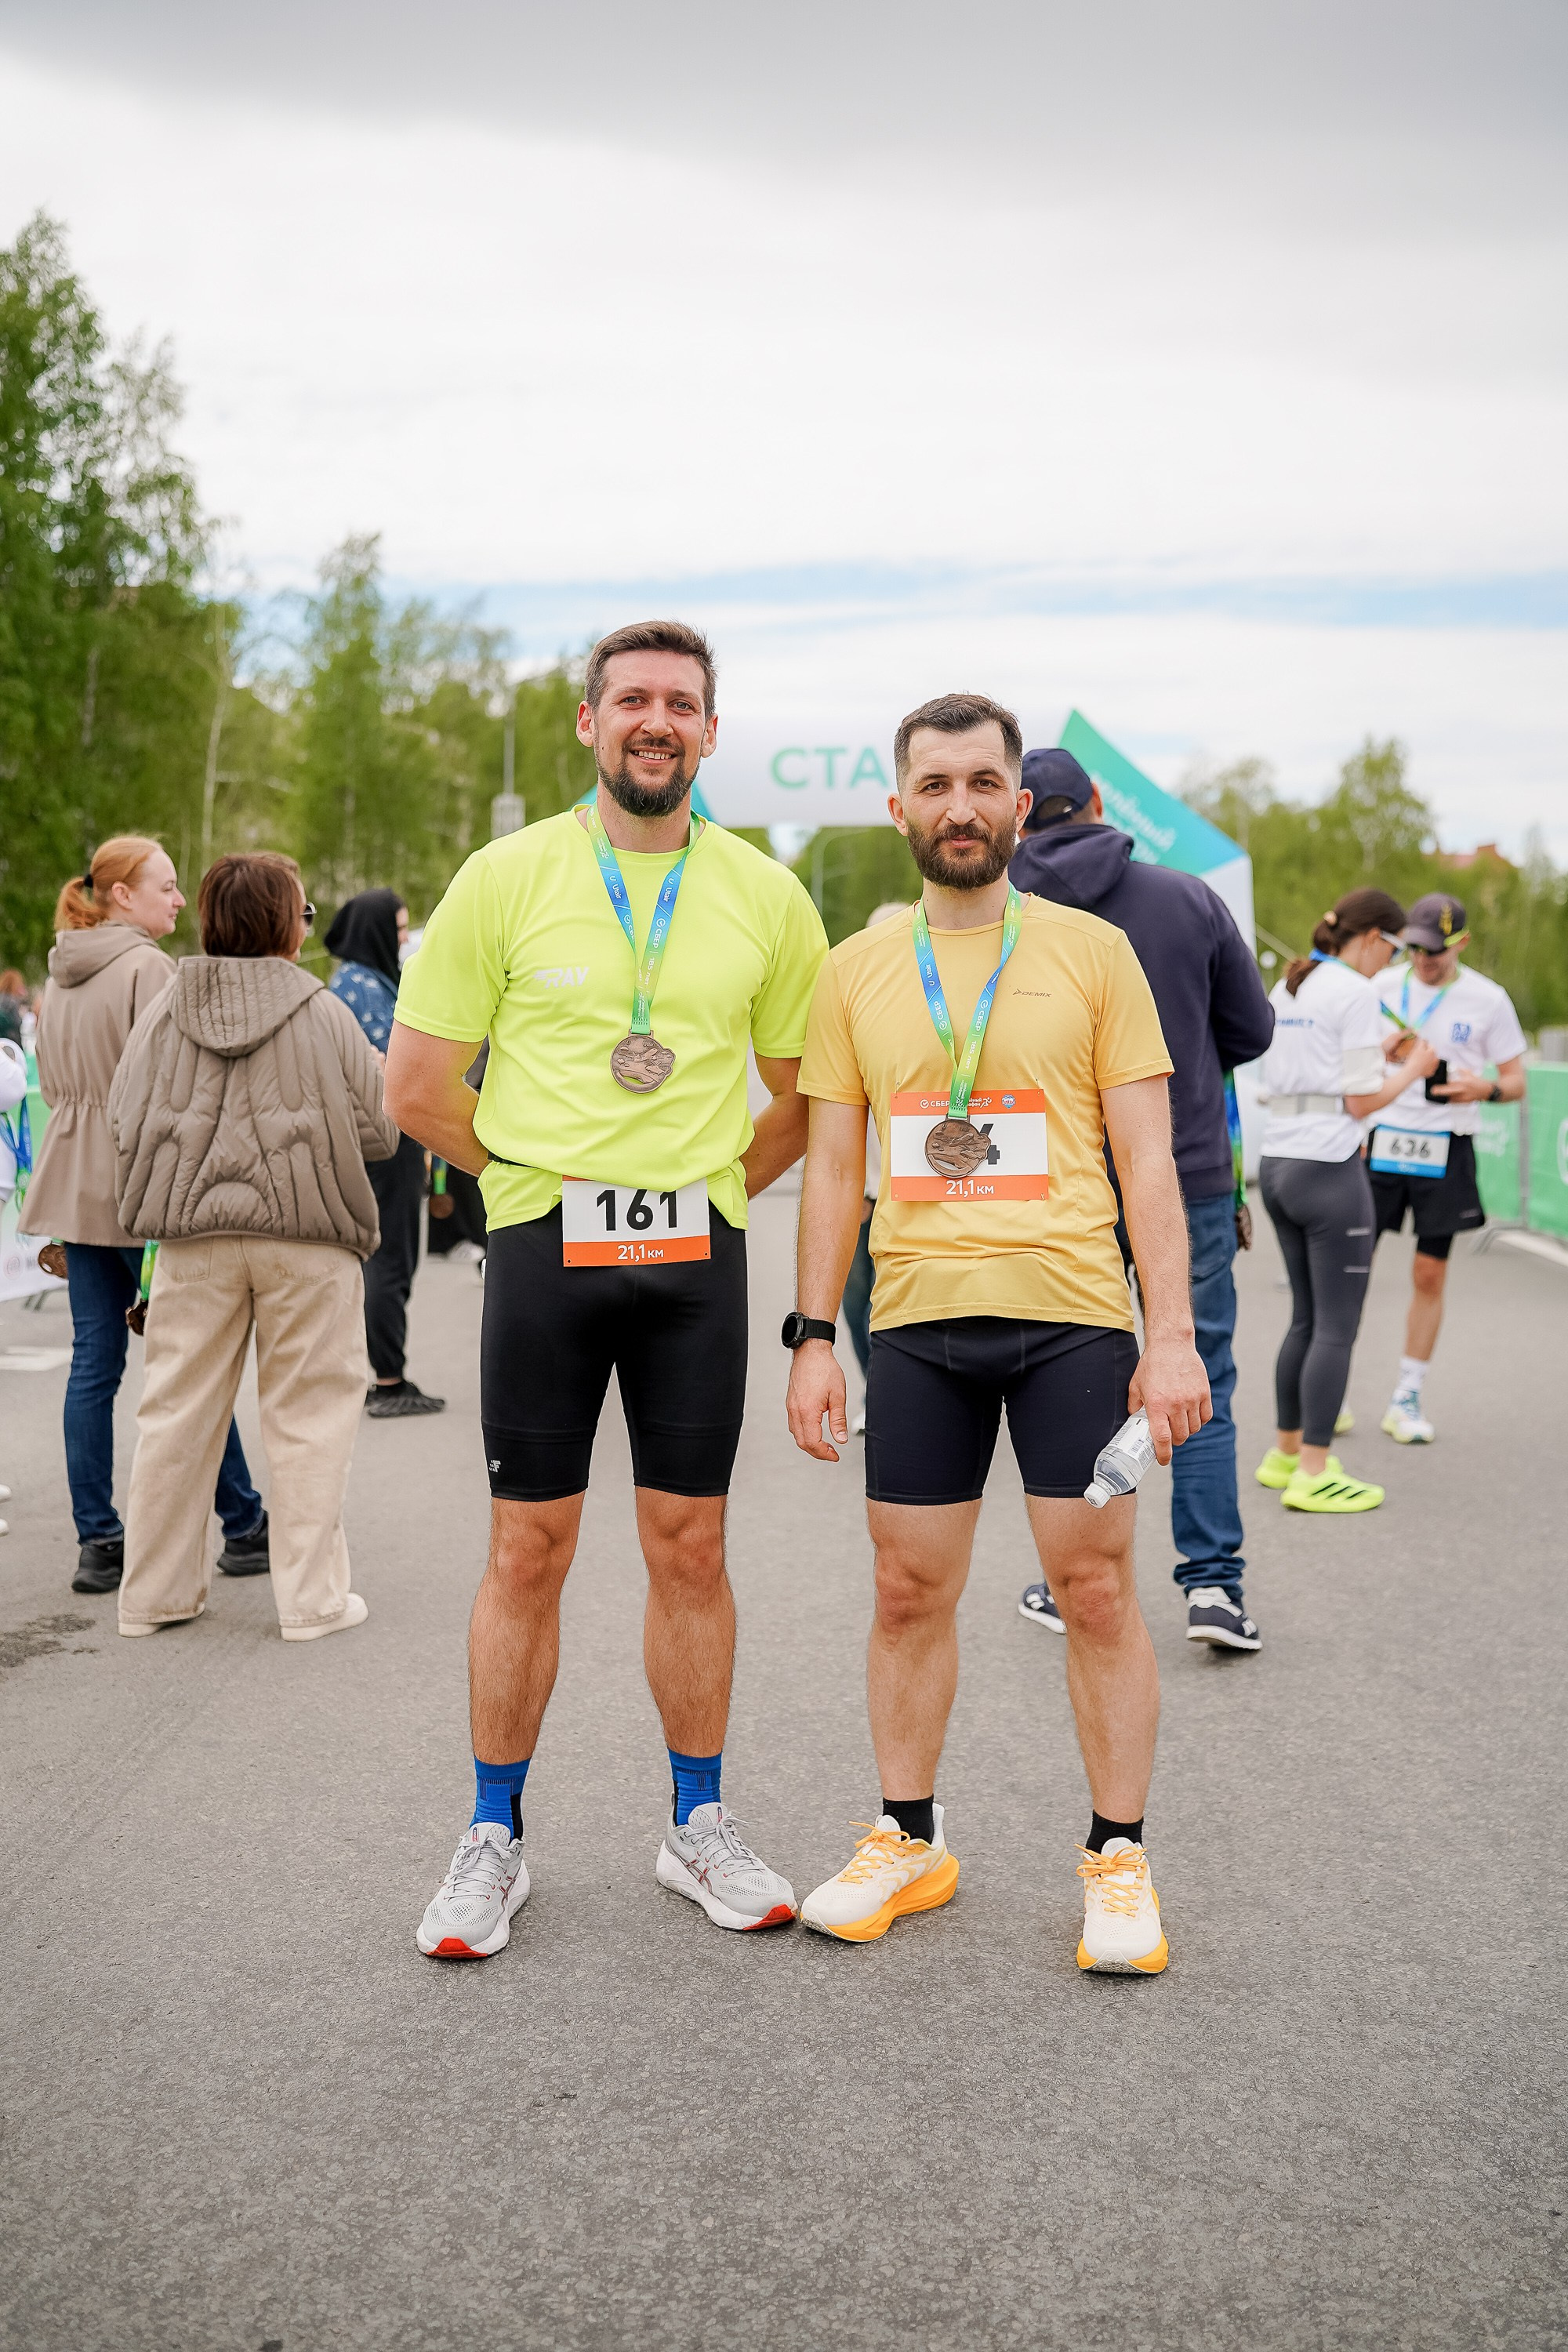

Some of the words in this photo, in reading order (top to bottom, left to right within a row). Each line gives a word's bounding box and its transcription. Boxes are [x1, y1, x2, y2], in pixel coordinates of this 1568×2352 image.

[653, 929, 662, 948] СБЕР
[935, 1000, 943, 1020] СБЕР
[975, 1011, 985, 1031] СБЕР
[1390, 1139, 1431, 1159] 636
[946, 1179, 974, 1197] 21,1
[597, 1189, 677, 1231] 161
[617, 1244, 645, 1262] 21,1
